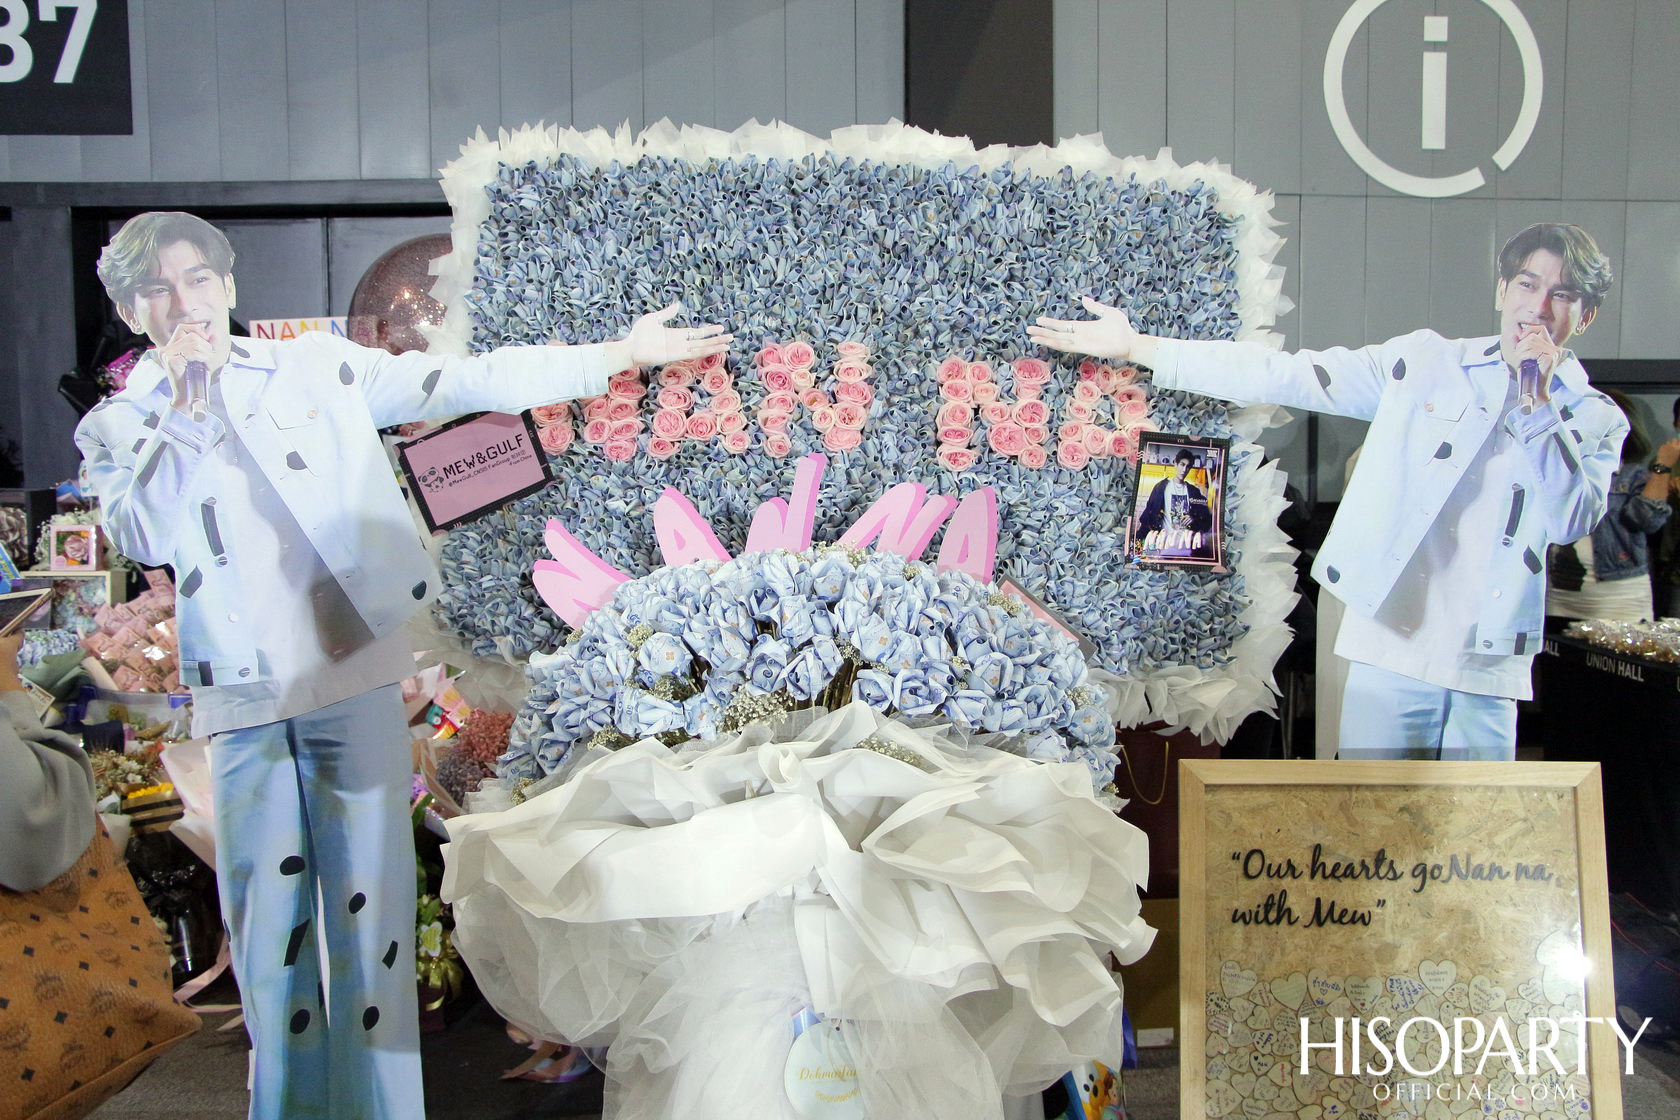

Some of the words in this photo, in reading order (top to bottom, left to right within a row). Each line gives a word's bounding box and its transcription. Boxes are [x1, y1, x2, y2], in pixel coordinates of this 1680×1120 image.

[443, 433, 523, 480] MEW&GULF
[1585, 650, 1616, 674] UNION
[1616, 660, 1645, 682] HALL
[1309, 842, 1404, 883] hearts
[1410, 861, 1446, 893] go
[1441, 852, 1511, 884] Nan
[1231, 889, 1300, 927] with
